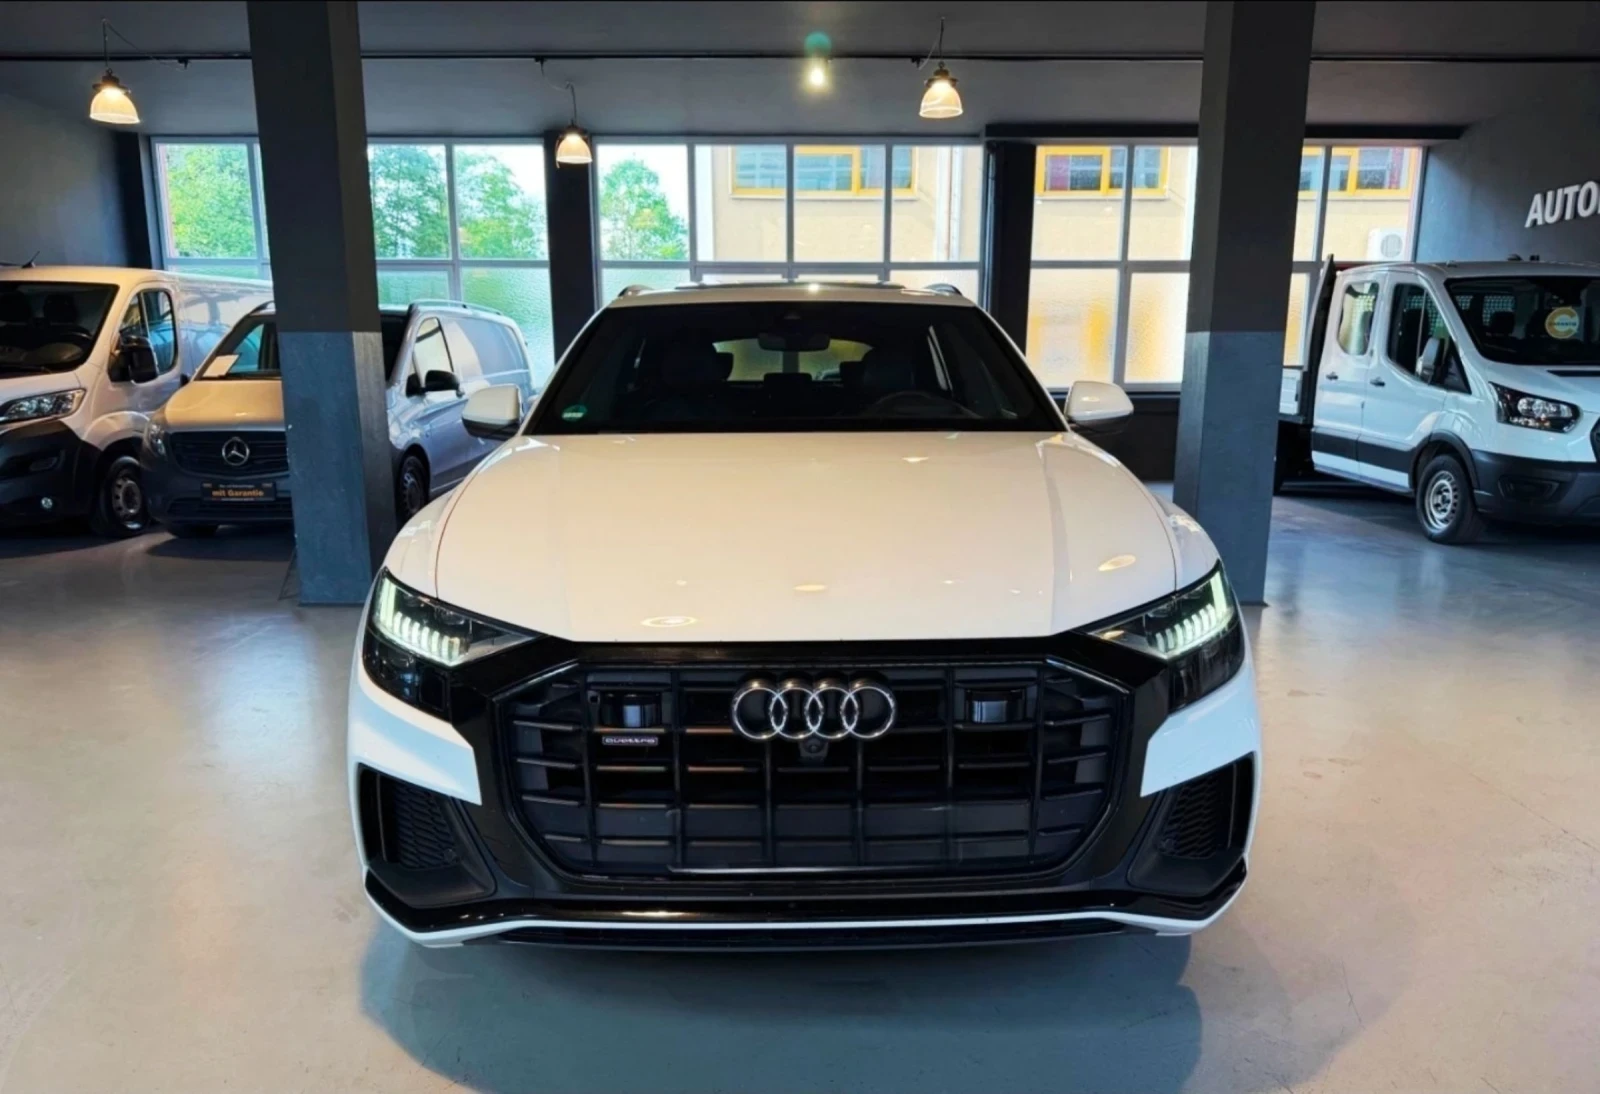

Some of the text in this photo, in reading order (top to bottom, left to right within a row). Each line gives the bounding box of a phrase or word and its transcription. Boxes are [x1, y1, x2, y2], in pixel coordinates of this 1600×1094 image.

[1524, 180, 1600, 229] AUTO
[212, 489, 265, 497] mit Garantie
